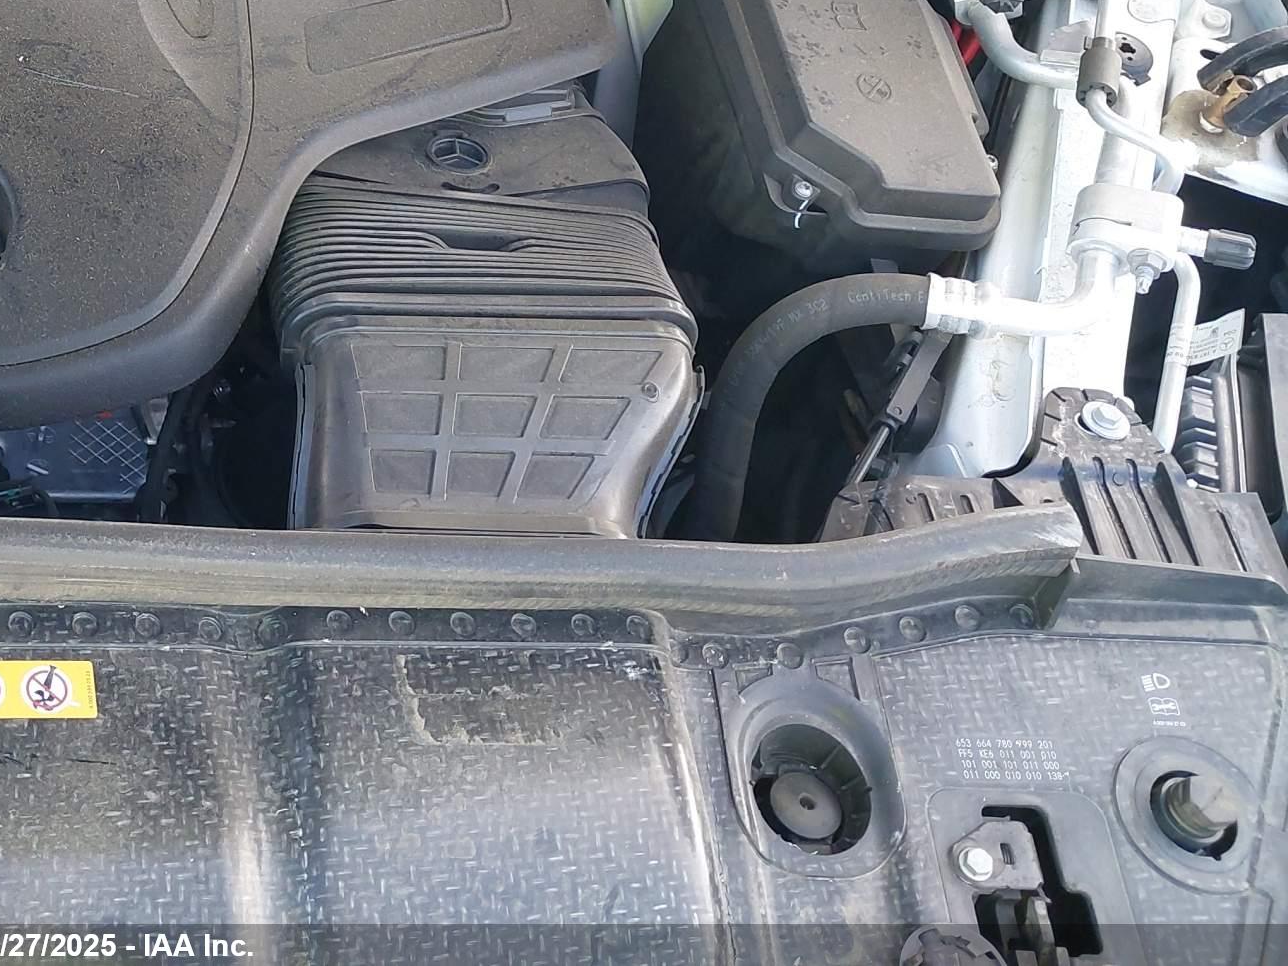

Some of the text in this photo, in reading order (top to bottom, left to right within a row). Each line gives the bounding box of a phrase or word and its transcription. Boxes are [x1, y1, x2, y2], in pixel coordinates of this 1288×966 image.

[955, 738, 972, 748] 653
[976, 739, 992, 748] 664
[996, 739, 1012, 748] 780
[1037, 740, 1053, 749] 201
[958, 748, 973, 758] FF5
[999, 750, 1014, 759] 011
[1020, 750, 1035, 759] 001
[961, 760, 1060, 770] 101 001 101 011 000
[963, 769, 979, 779] 011
[984, 770, 1000, 780] 000
[1005, 770, 1021, 780] 010
[1025, 771, 1042, 780] 010
